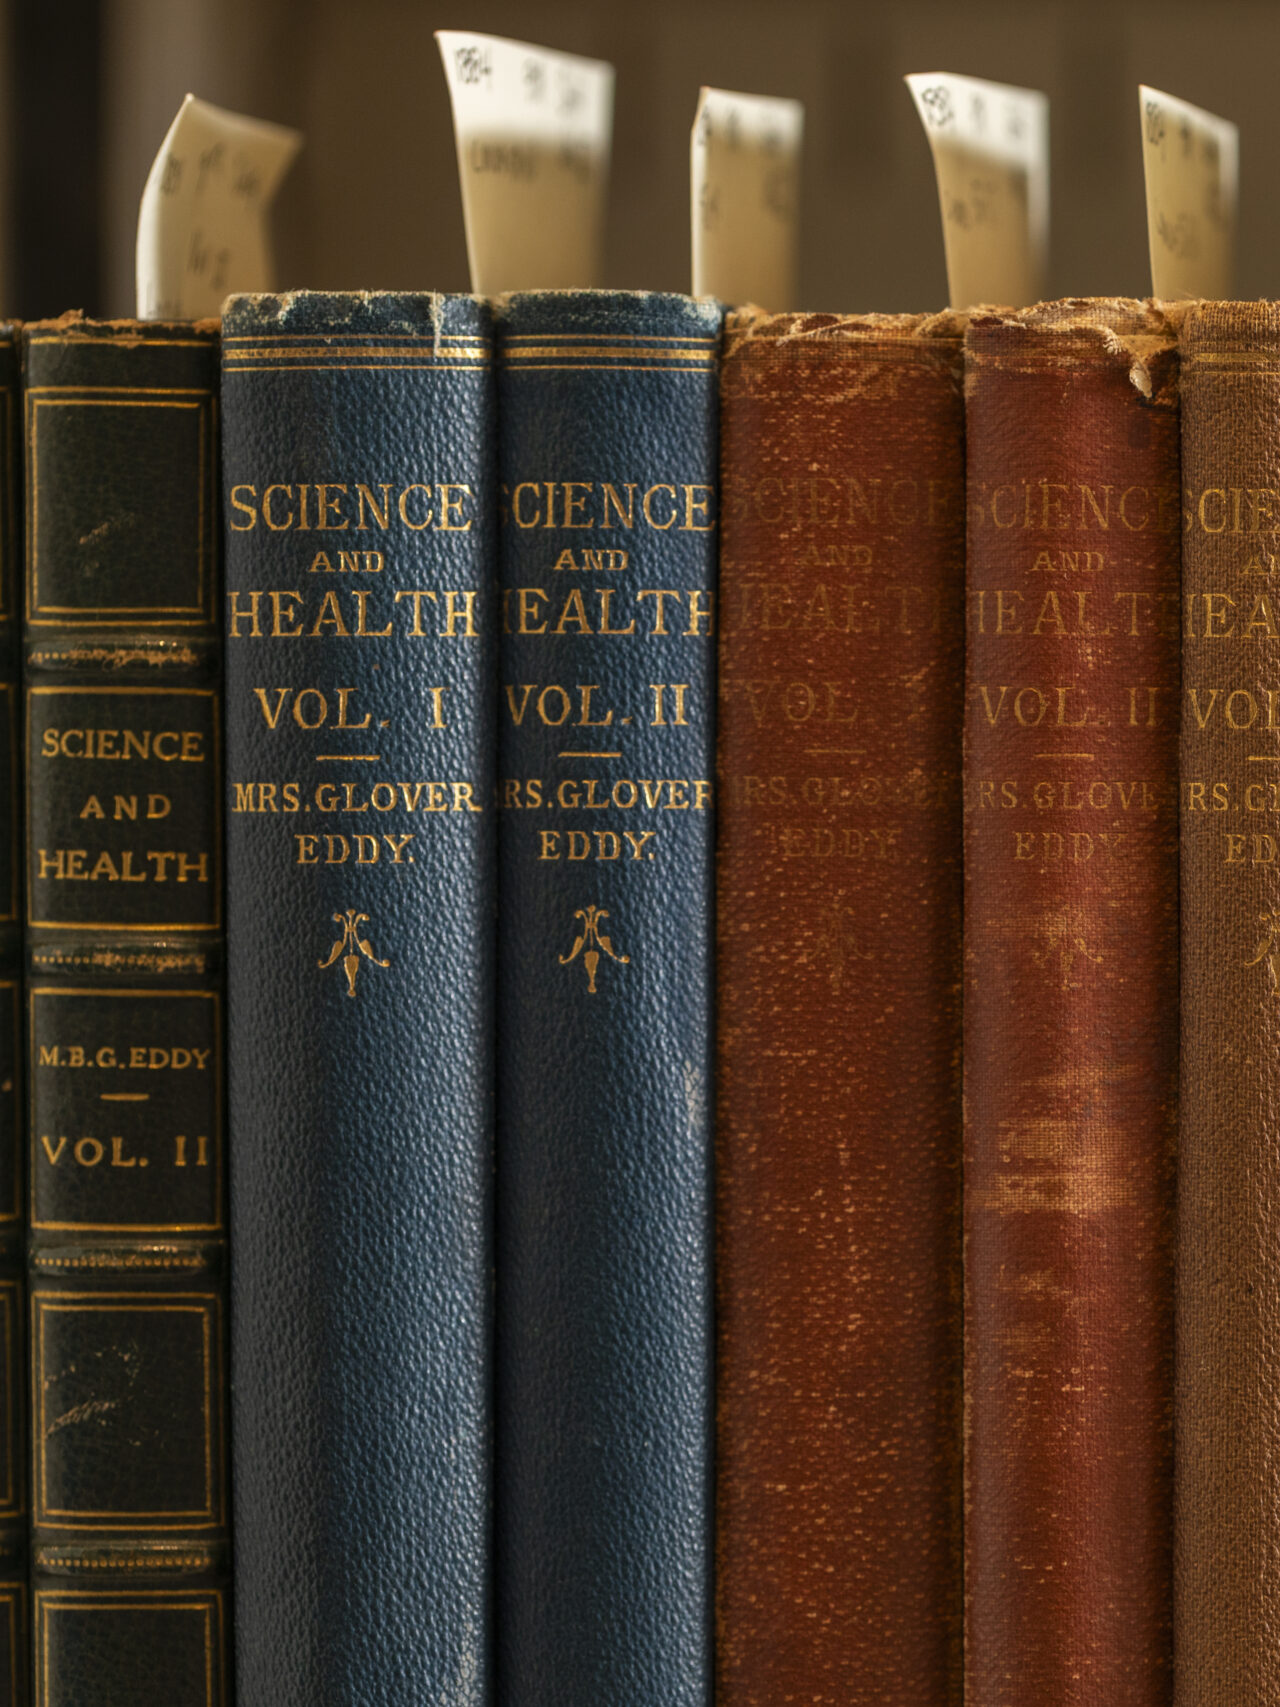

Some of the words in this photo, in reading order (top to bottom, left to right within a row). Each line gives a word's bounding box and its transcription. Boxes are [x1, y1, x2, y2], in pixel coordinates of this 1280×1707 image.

[229, 483, 475, 531] SCIENCE
[501, 482, 716, 531] CIENCE
[308, 551, 385, 572] AND
[553, 549, 630, 571] AND
[1031, 551, 1104, 572] AND
[226, 591, 480, 637] HEALTH
[254, 688, 390, 729] VOL.
[430, 687, 450, 729] I
[505, 685, 633, 726] VOL.
[650, 684, 689, 726] II
[1126, 686, 1159, 727] II
[41, 728, 205, 762] SCIENCE
[79, 794, 172, 820] AND
[502, 779, 715, 810] RS.GLOVER
[295, 834, 416, 864] EDDY.
[537, 830, 656, 861] EDDY.
[37, 849, 208, 882] HEALTH
[41, 1135, 149, 1167] VOL.
[174, 1136, 208, 1166] II
